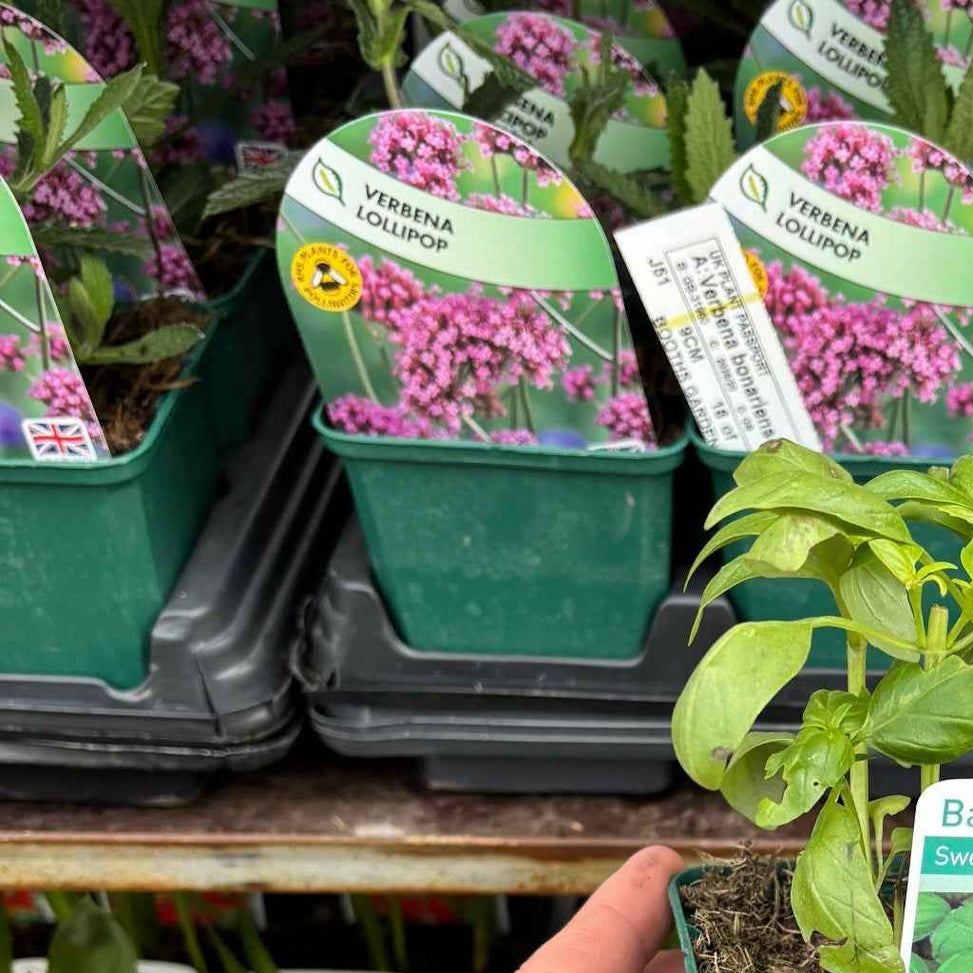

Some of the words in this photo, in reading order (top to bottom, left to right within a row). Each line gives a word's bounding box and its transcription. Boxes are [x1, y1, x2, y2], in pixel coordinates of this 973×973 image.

[830, 22, 887, 66] VERBEN
[356, 205, 449, 253] LOLLIPOP
[364, 183, 455, 235] VERBENA
[789, 191, 870, 246] VERBENA
[775, 211, 862, 262] LOLLIPOP
[699, 274, 739, 349] Verbena
[708, 249, 726, 270] UK
[719, 270, 743, 310] PLANT
[734, 313, 770, 377] PASSPORT
[680, 326, 705, 364] 9CM
